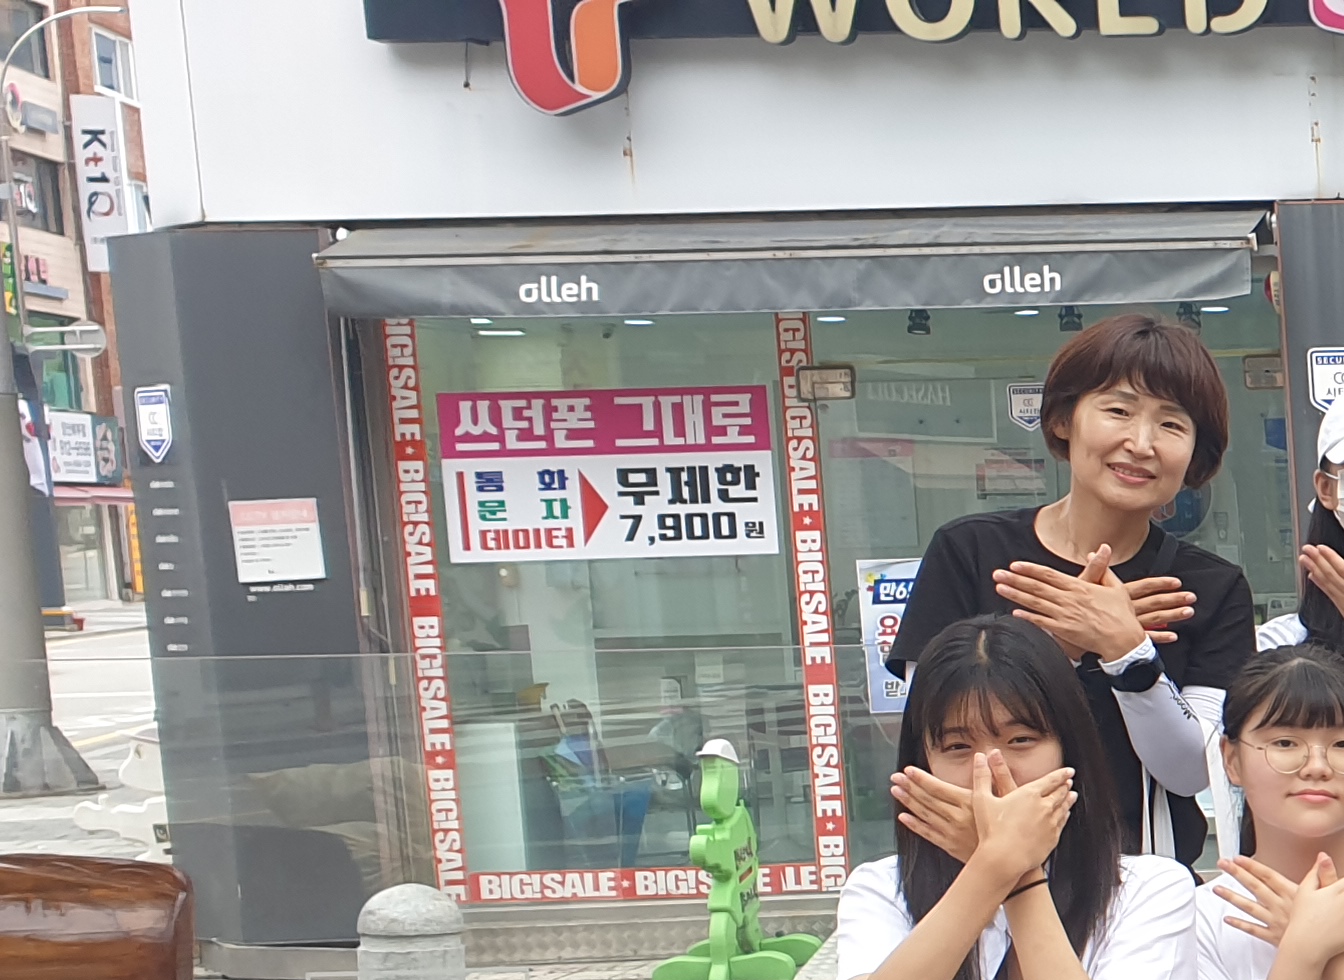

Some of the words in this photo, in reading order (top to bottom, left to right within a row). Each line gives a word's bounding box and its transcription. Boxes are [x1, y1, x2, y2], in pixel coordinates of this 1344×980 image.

[518, 274, 600, 304] olleh
[983, 264, 1061, 294] olleh
[454, 397, 597, 452] 쓰던폰
[613, 393, 756, 448] 그대로
[616, 464, 761, 507] 무제한
[478, 527, 576, 551] 데이터
[619, 511, 738, 547] 7,900
[744, 519, 766, 540] 원
[479, 870, 617, 900] BIG!SALE
